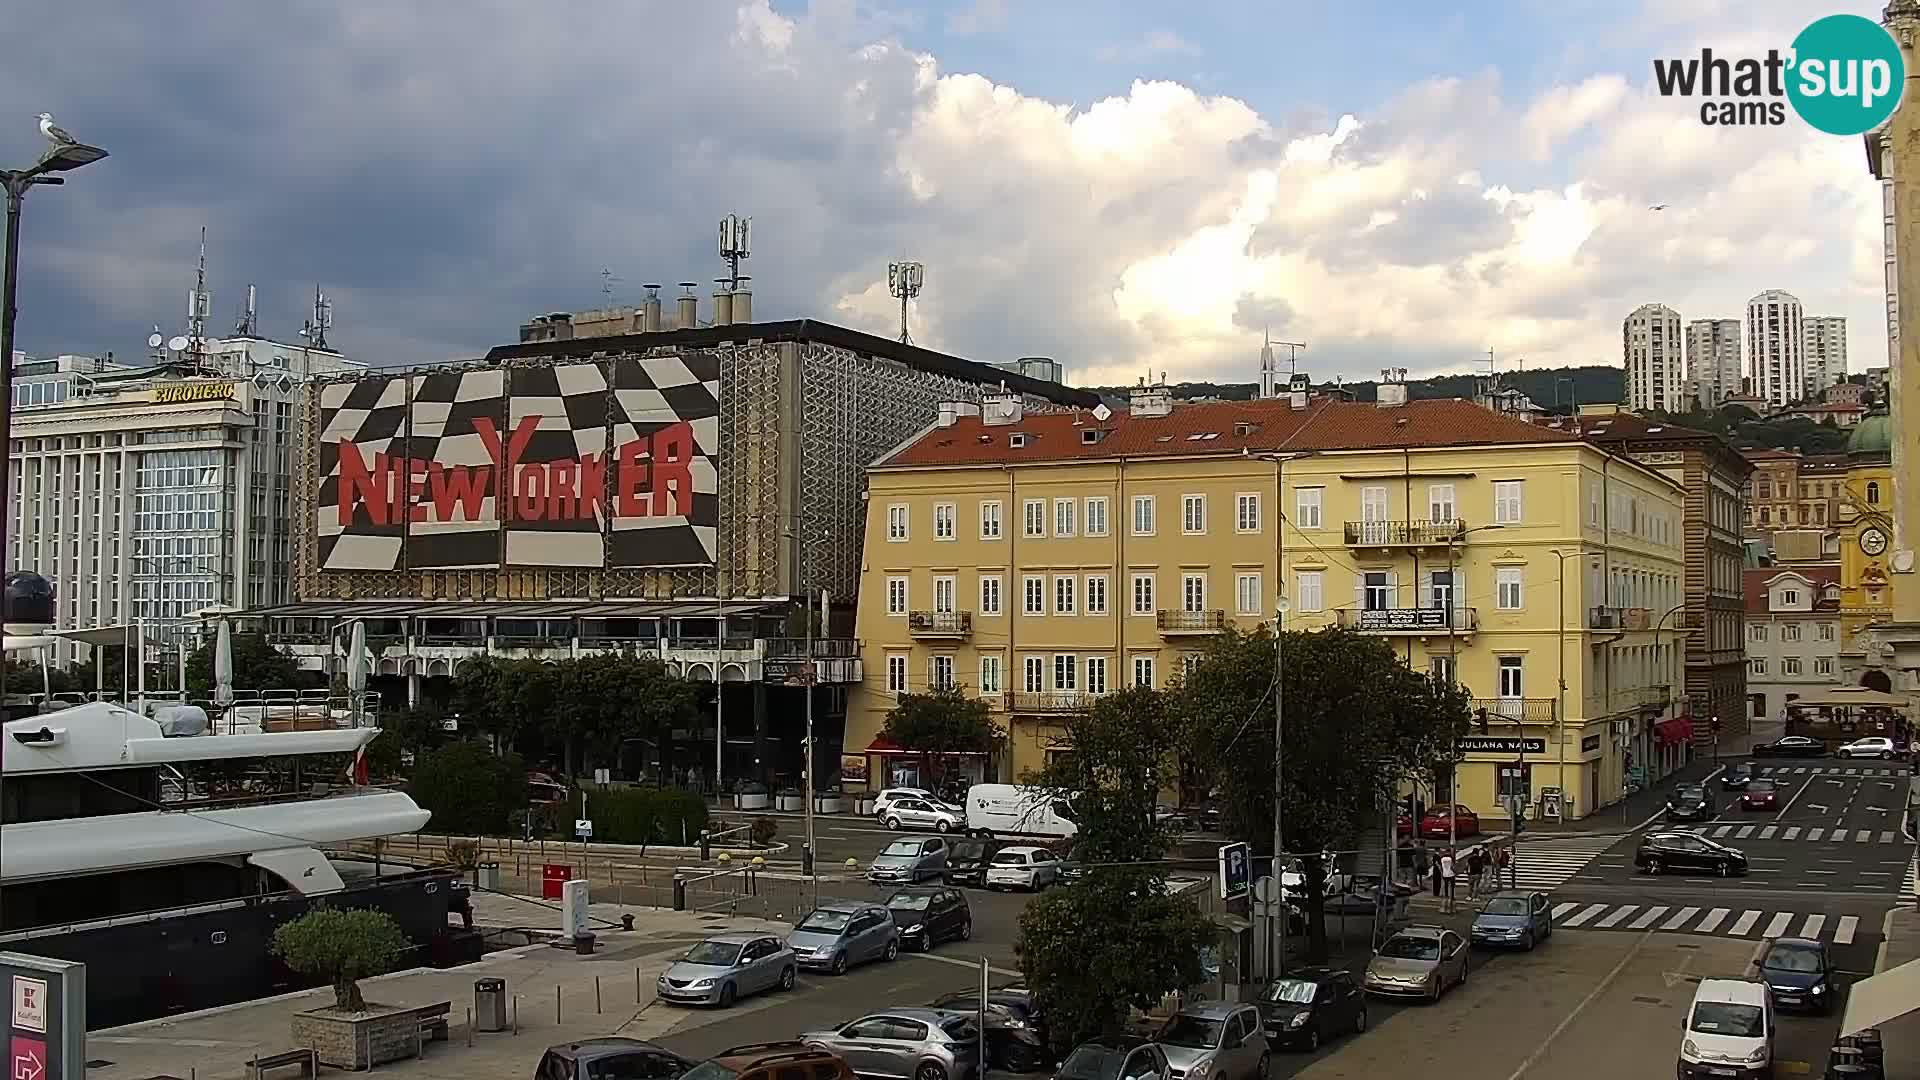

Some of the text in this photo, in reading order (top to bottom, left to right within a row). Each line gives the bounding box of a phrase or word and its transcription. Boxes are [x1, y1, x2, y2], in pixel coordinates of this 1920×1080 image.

[339, 414, 694, 526] NEW YORKER
[1458, 741, 1540, 750] JULIANA NAILS
